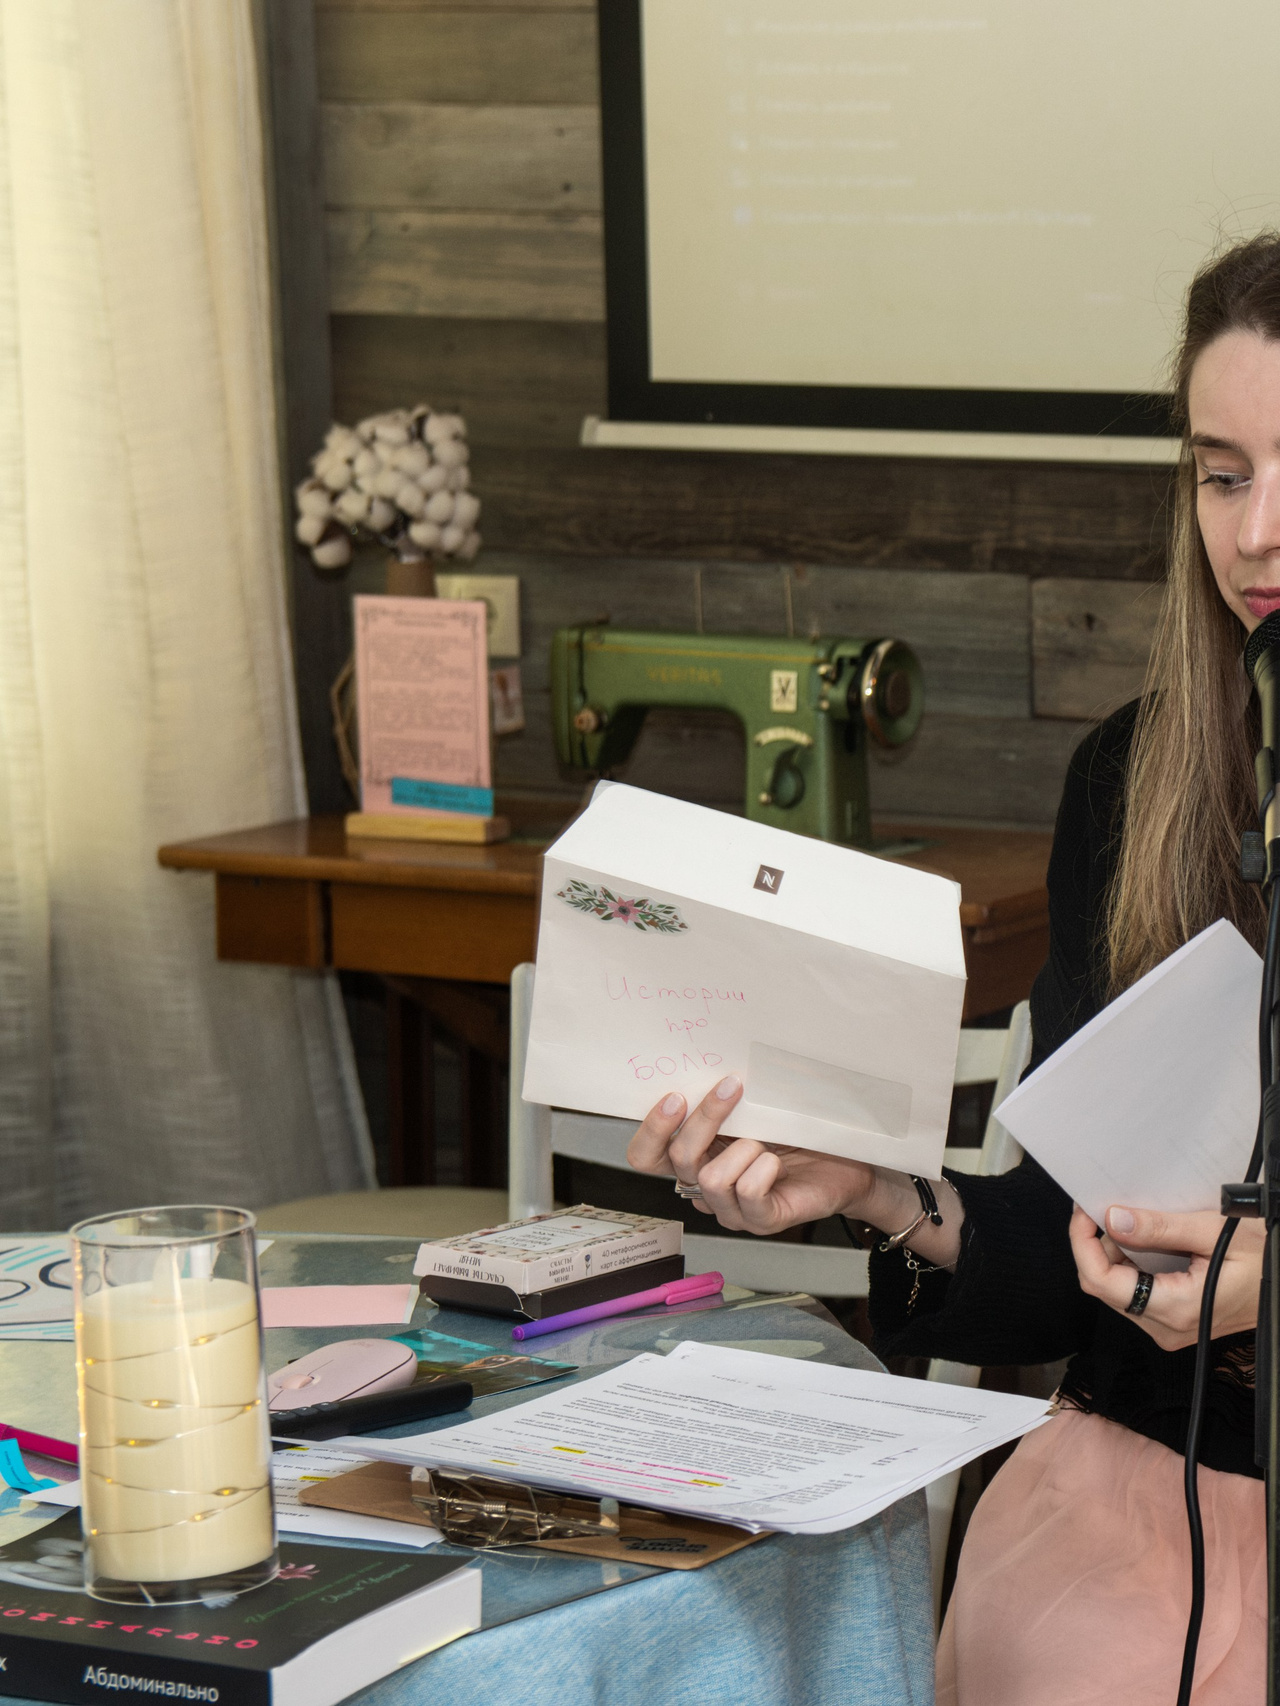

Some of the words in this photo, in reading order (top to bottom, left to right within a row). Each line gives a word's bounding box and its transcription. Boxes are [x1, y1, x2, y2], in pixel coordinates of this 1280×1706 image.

[605, 972, 746, 1014] Истории
[665, 1018, 708, 1042] про
[600, 1260, 613, 1271] карт
[618, 1248, 662, 1267] аффирмациями
[610, 1238, 659, 1257] метафорических
[0, 1606, 260, 1650] ОМИНАЛЬНО
[83, 1664, 220, 1703] Абдоминально
